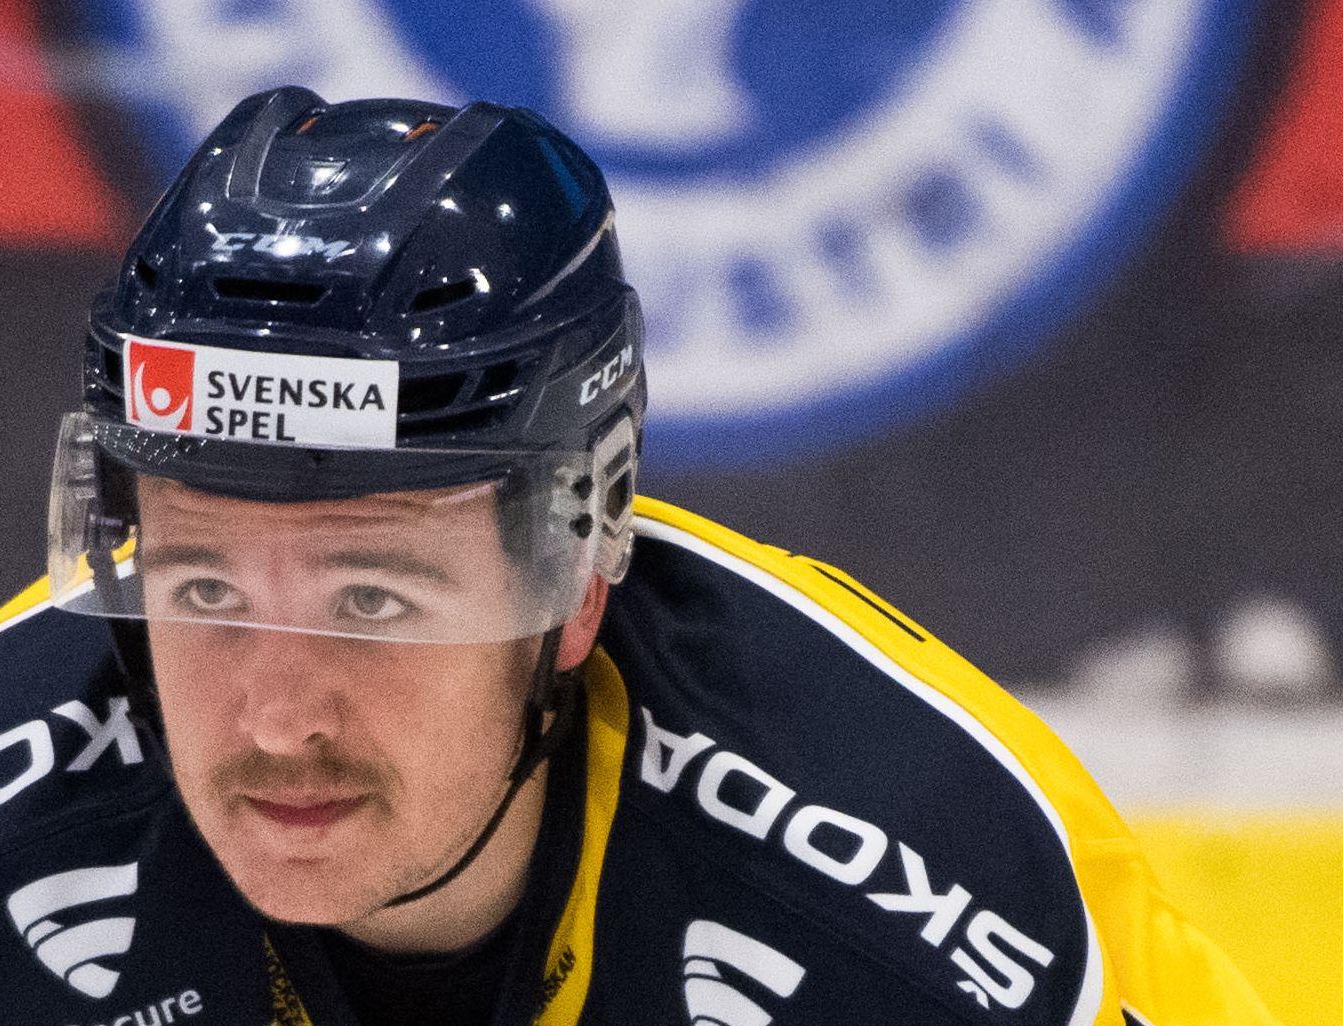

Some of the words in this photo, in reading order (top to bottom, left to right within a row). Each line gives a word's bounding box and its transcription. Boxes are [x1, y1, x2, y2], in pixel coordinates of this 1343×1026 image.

[206, 369, 386, 412] SVENSKA
[577, 343, 634, 406] CCM
[204, 406, 296, 443] SPEL
[639, 704, 1055, 1011] ŠKODA
